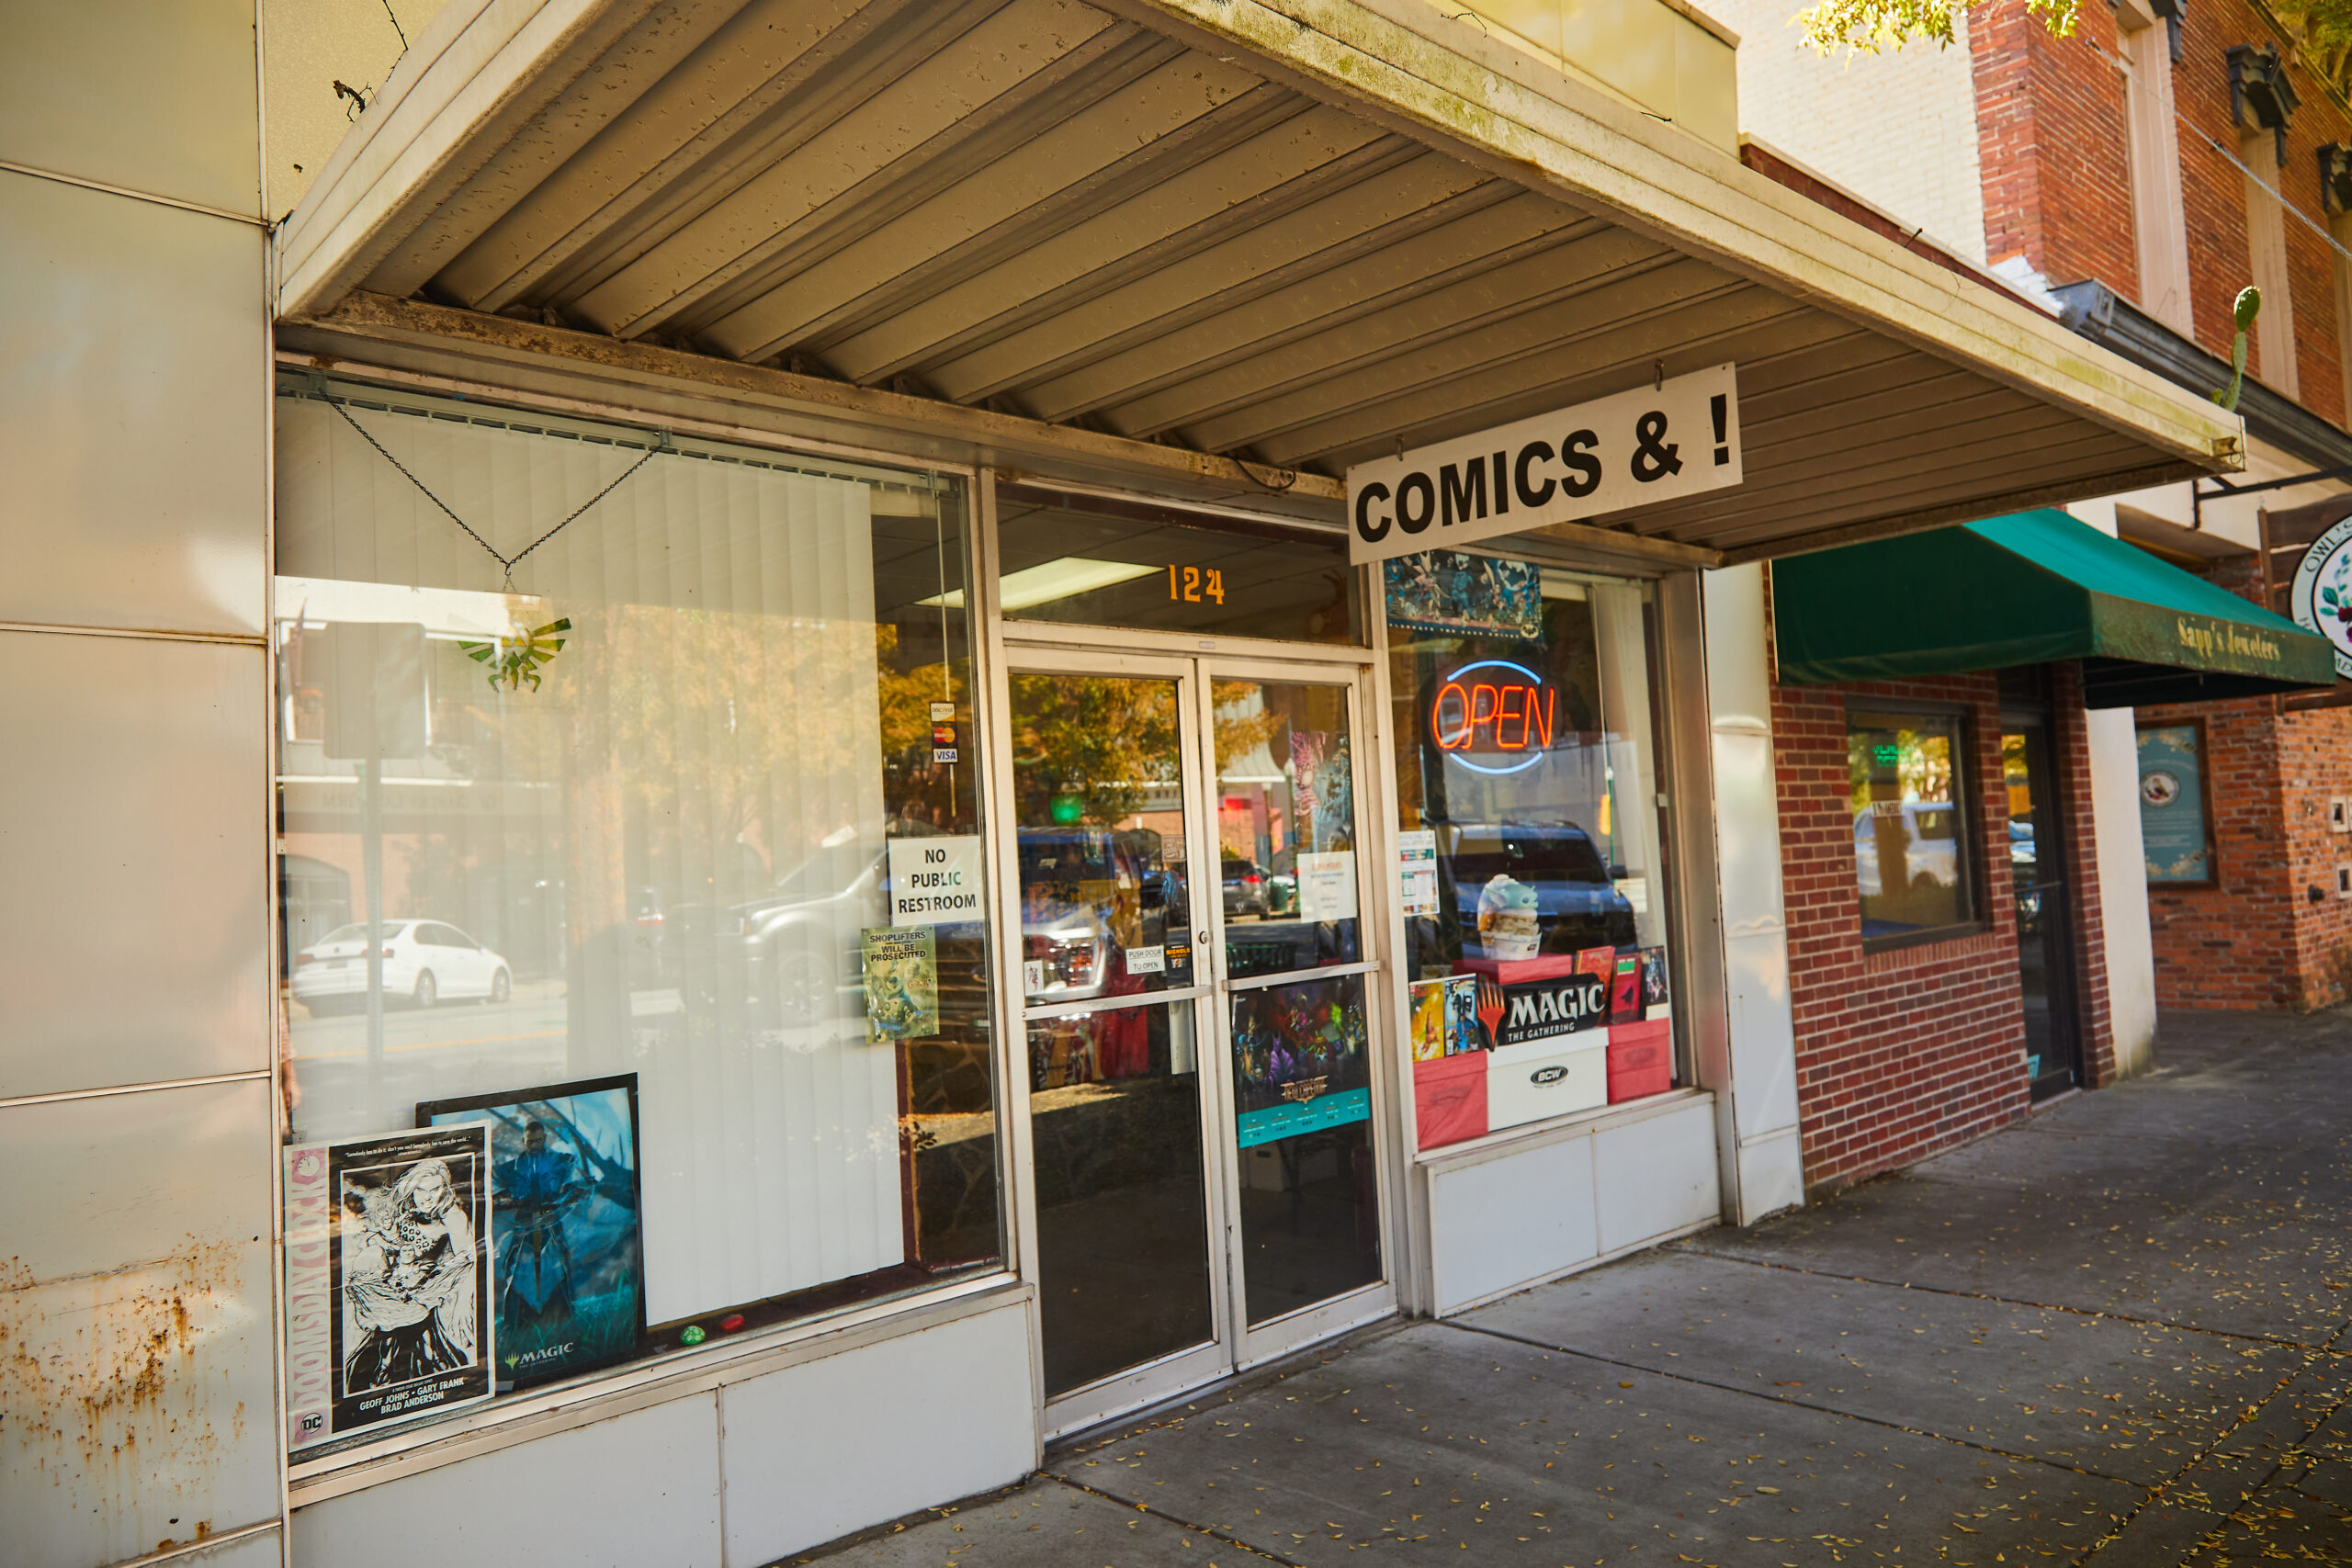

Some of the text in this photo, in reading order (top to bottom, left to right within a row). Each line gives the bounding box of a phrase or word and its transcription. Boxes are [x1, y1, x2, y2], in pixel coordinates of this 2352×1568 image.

[1355, 393, 1730, 544] COMICS & !
[1168, 563, 1226, 605] 124
[2177, 616, 2225, 658] Sapp's
[1432, 682, 1555, 750] OPEN
[935, 750, 956, 761] VISA
[924, 848, 946, 864] NO
[910, 871, 962, 889] PUBLIC
[898, 893, 977, 914] RESTROOM
[869, 931, 926, 943] SHOPLIFTERS
[871, 951, 926, 962] PROSECUTED
[882, 945, 902, 953] WILL
[1508, 984, 1607, 1028] MAGIC
[1508, 1022, 1576, 1043] THE GATHERING
[1537, 1068, 1563, 1082] BCW
[290, 1176, 328, 1408] DOOMSDAY CLOCK
[519, 1341, 573, 1366] MAGIC
[359, 1397, 383, 1411] GEOFF
[385, 1390, 410, 1404] JOHNS
[417, 1382, 438, 1396] GARY
[439, 1377, 466, 1391] FRANK
[380, 1390, 445, 1415] BRAD ANDERSON
[300, 1416, 322, 1431] DC
